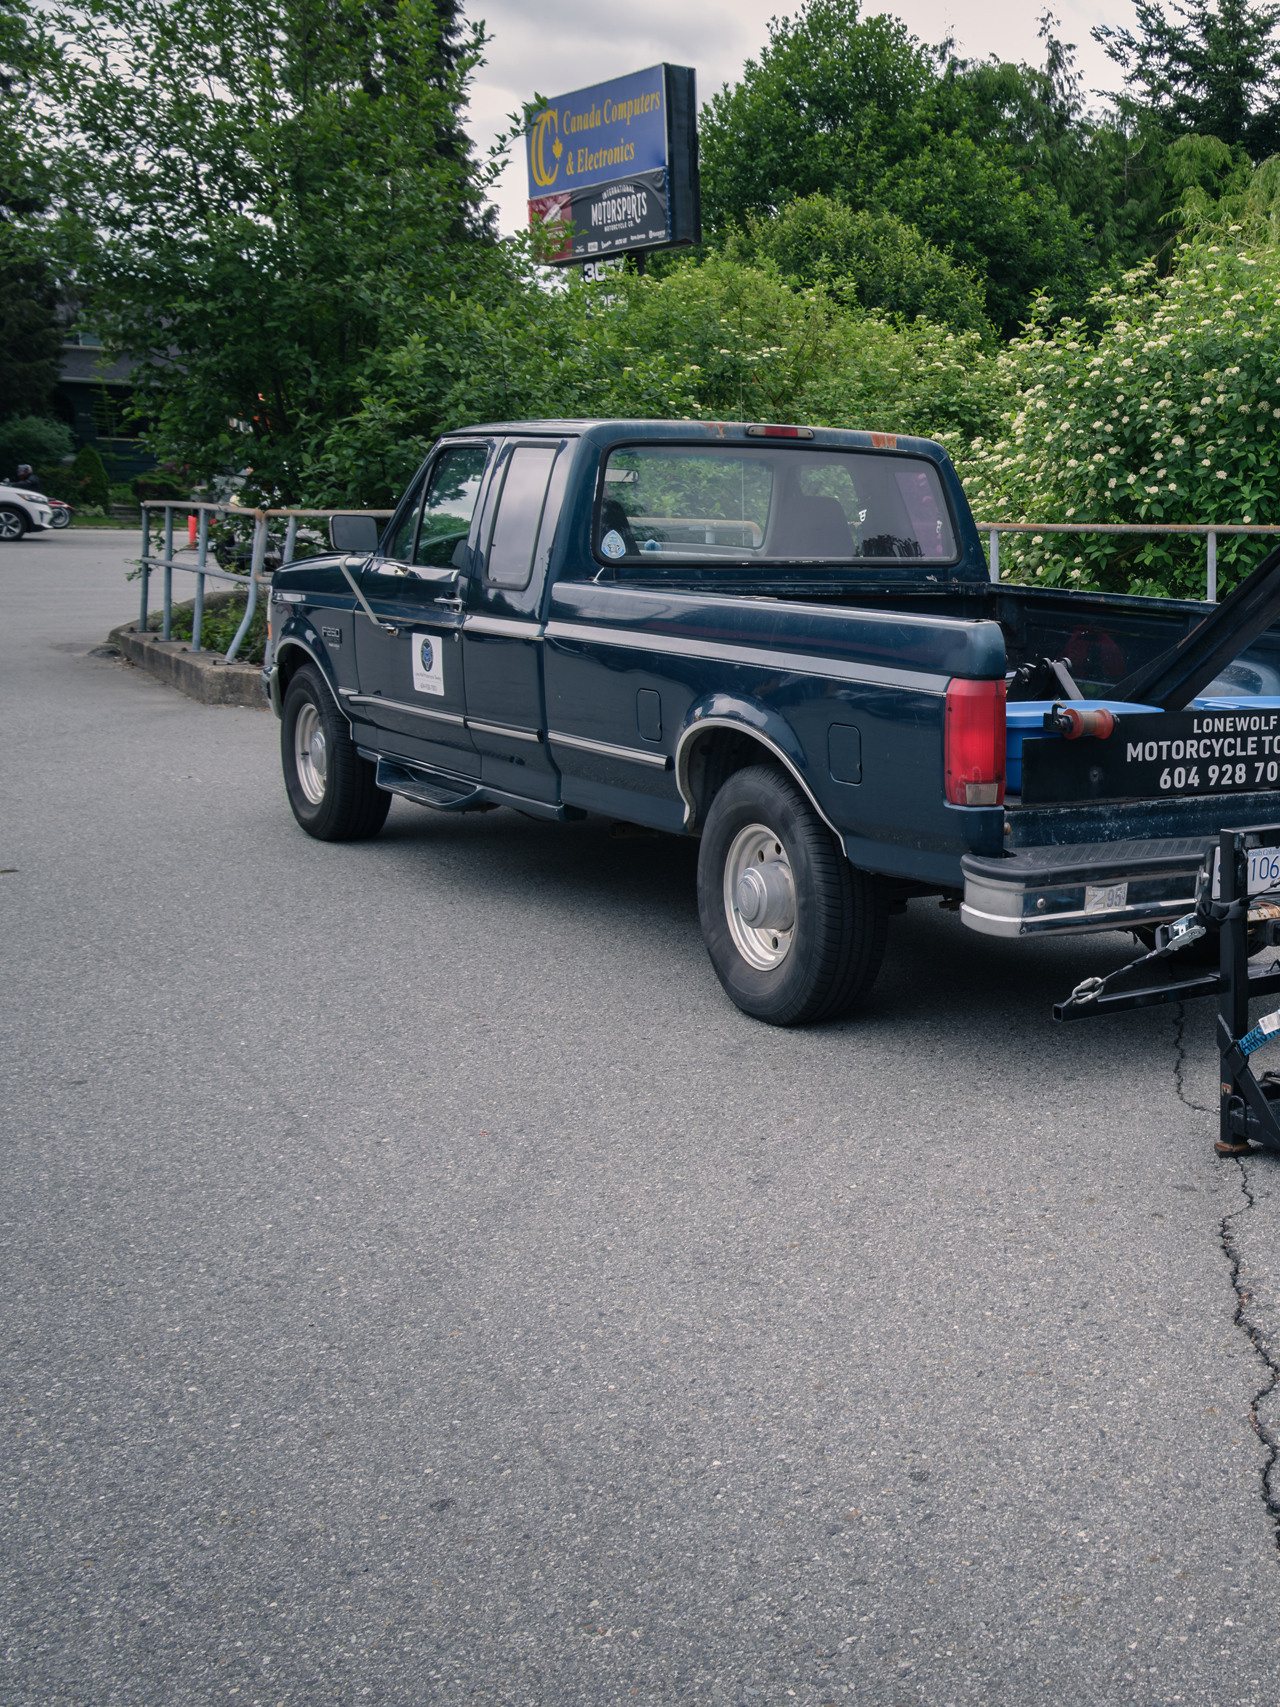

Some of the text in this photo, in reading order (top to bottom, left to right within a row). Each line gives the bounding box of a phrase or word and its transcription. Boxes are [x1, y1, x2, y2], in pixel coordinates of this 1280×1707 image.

[563, 91, 661, 135] Canada Computers
[566, 138, 635, 176] & Electronics
[591, 191, 647, 226] MOTORSPORTS
[1193, 715, 1278, 734] LONEWOLF
[1126, 736, 1258, 762] MOTORCYCLE
[1159, 766, 1200, 789] 604
[1208, 763, 1246, 786] 928
